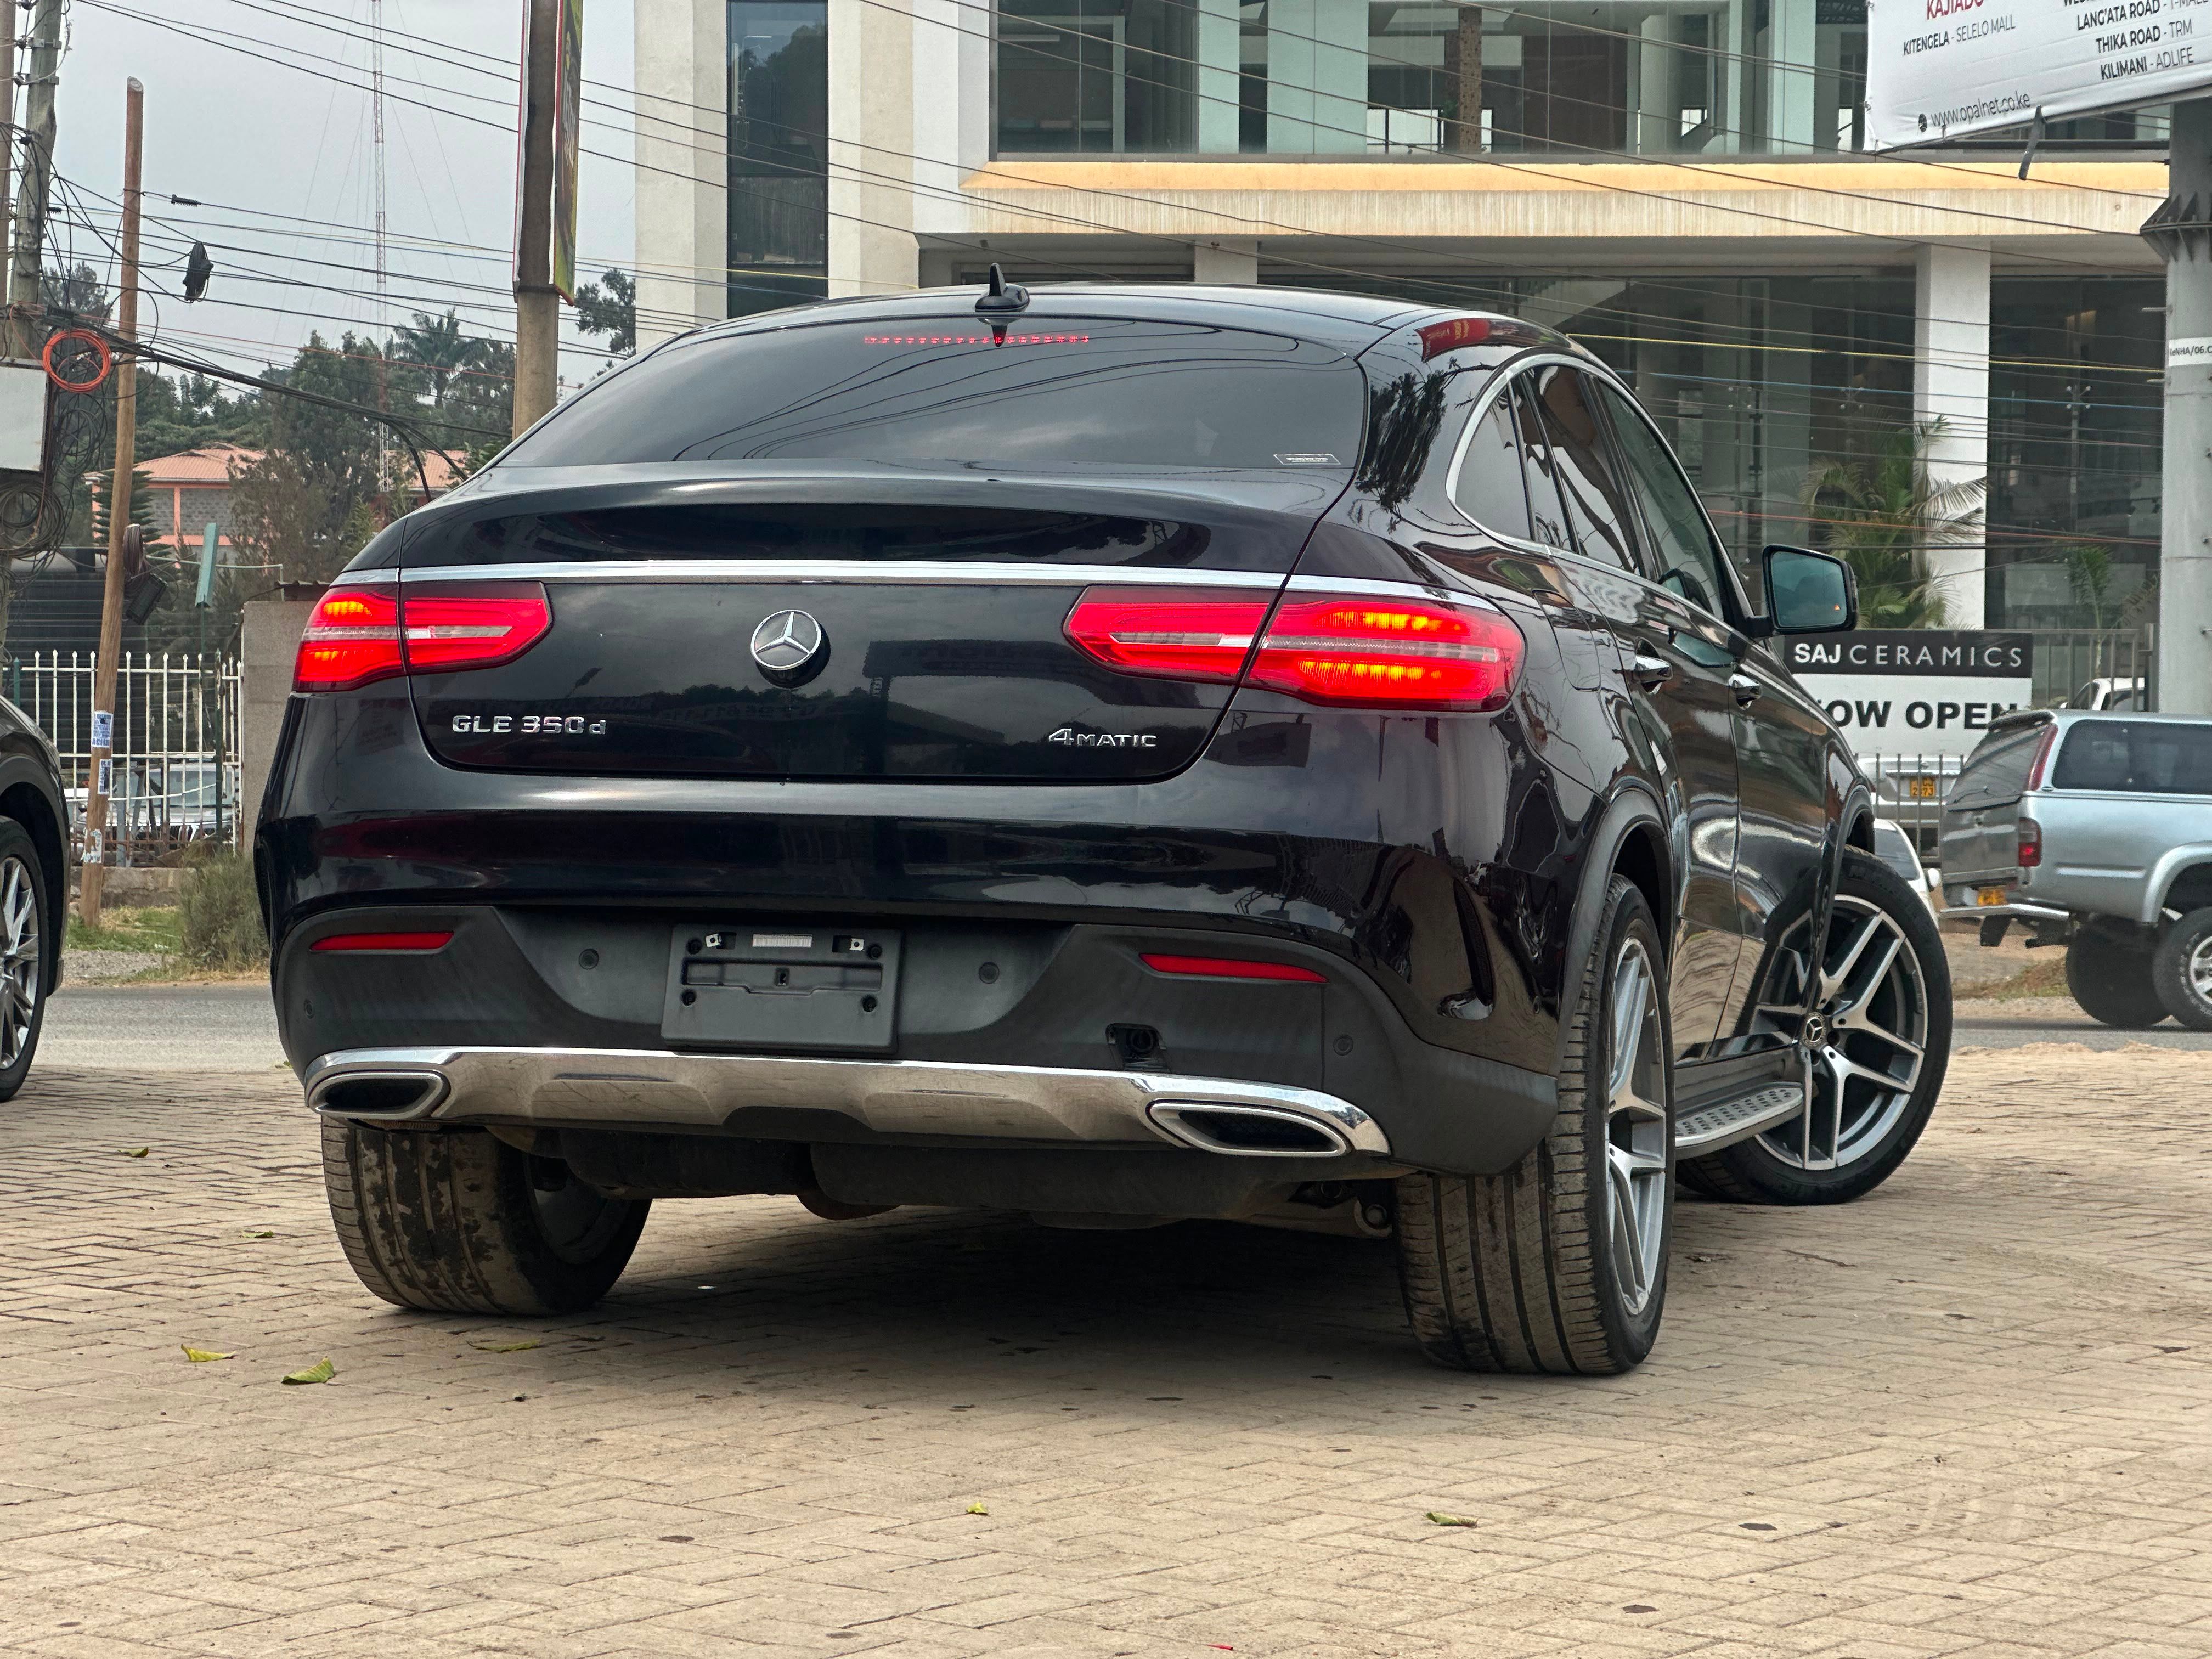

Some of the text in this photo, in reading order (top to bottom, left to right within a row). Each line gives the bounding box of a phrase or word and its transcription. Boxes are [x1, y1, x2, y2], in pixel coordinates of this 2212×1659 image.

[2077, 4, 2127, 31] LANG'ATA
[2129, 0, 2160, 19] ROAD
[1903, 31, 1950, 55] KITENGELA
[1956, 20, 1989, 42] SELELO
[1991, 14, 2016, 34] MALL
[2096, 33, 2128, 54] THIKA
[2130, 25, 2160, 47] ROAD
[2169, 18, 2192, 38] TRM
[2100, 56, 2148, 80] KILIMANI
[2156, 47, 2194, 70] ADLIFE
[1931, 90, 2031, 127] www.opalnet.co.ke
[1795, 643, 2022, 667] SAJ CERAMICS
[452, 715, 606, 735] GLE 350 d
[1818, 699, 1892, 727] OW
[1048, 728, 1158, 747] 4MATIC
